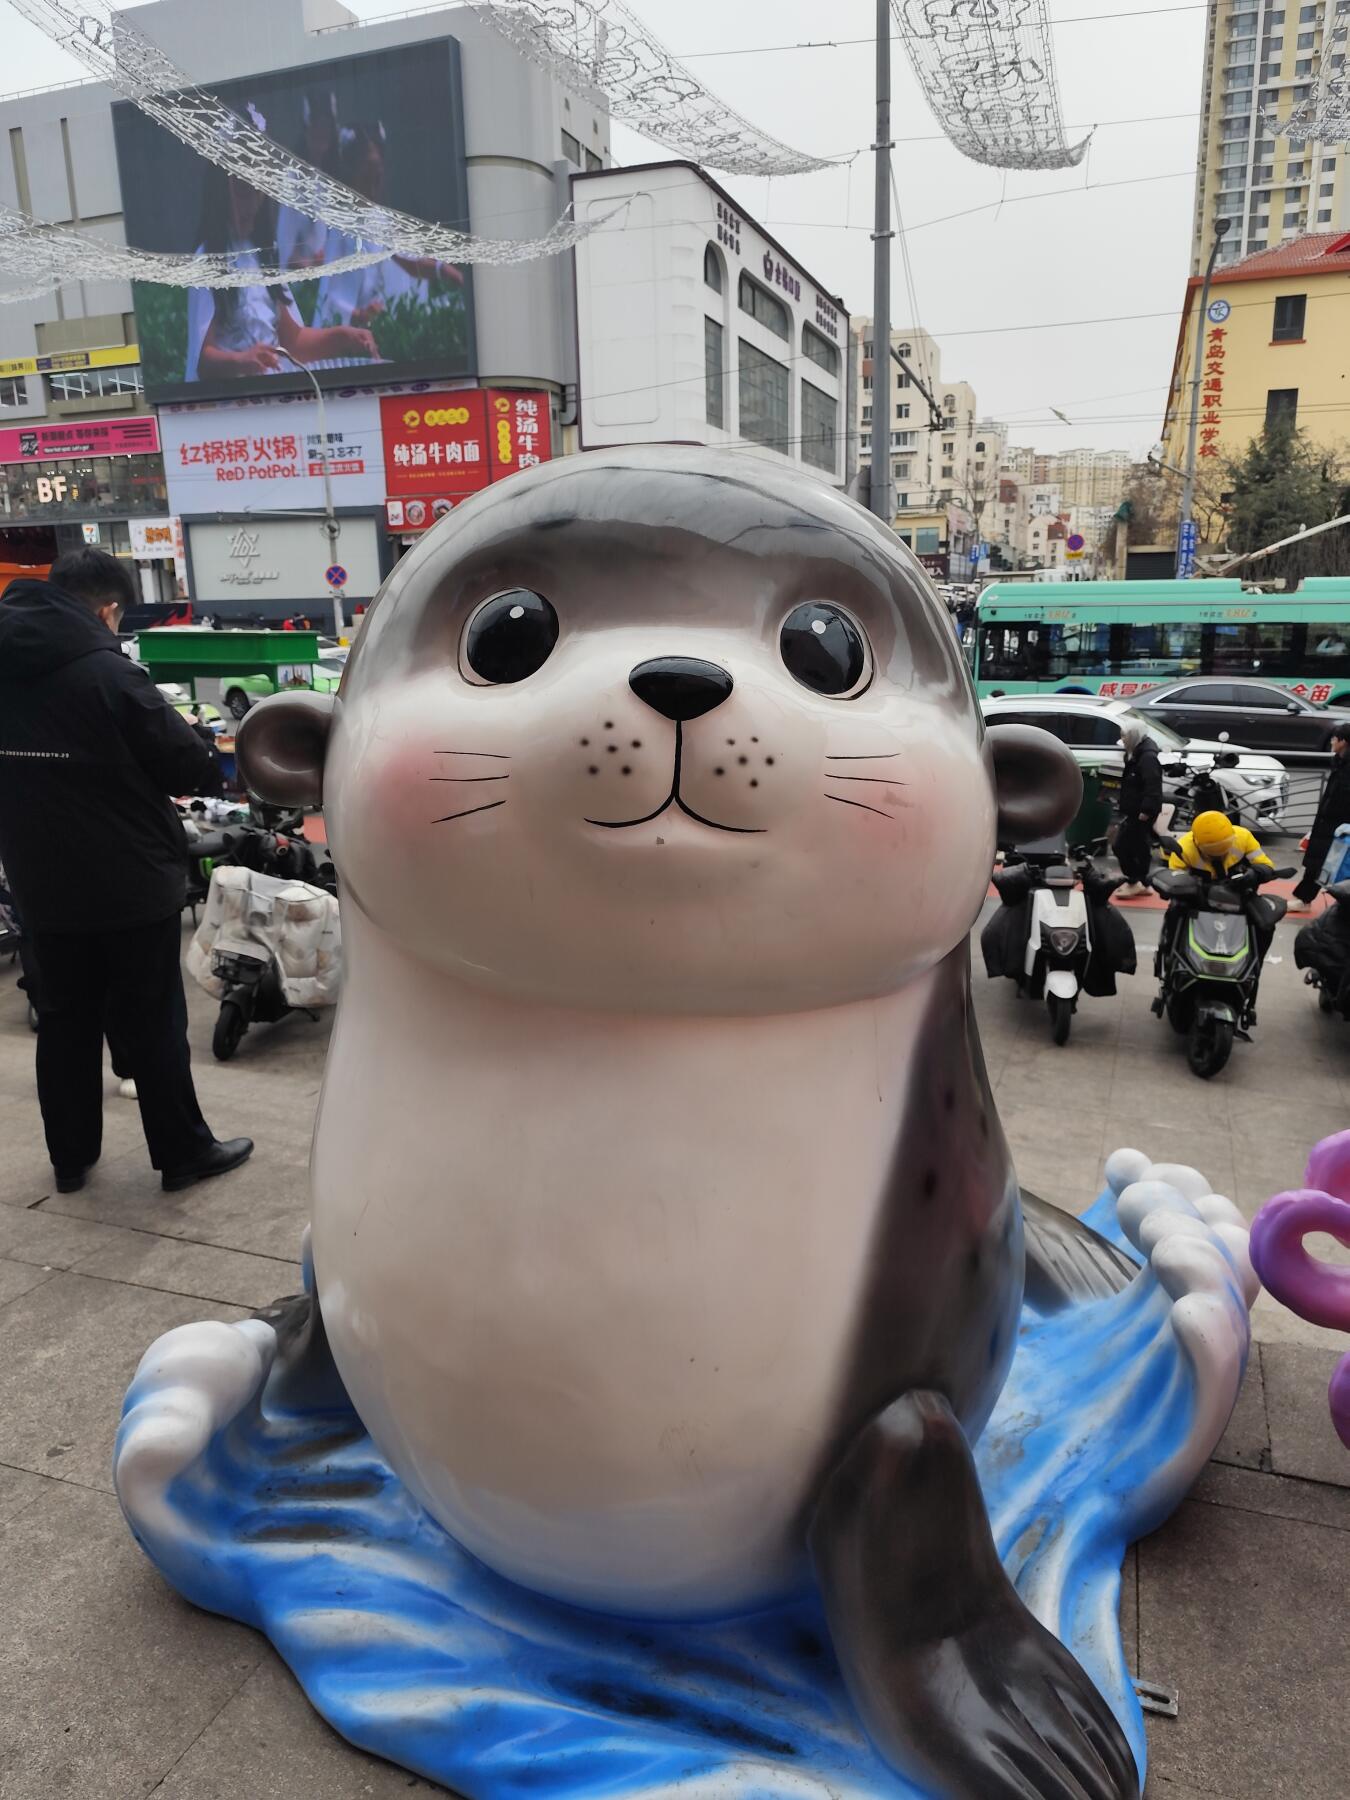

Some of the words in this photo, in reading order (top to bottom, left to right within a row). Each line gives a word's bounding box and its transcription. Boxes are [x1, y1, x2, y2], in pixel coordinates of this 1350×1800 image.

[1199, 328, 1228, 457] 青岛交通职业学校
[393, 440, 480, 467] 纯汤牛肉面
[515, 399, 540, 468] 纯汤牛肉
[37, 476, 67, 504] BF
